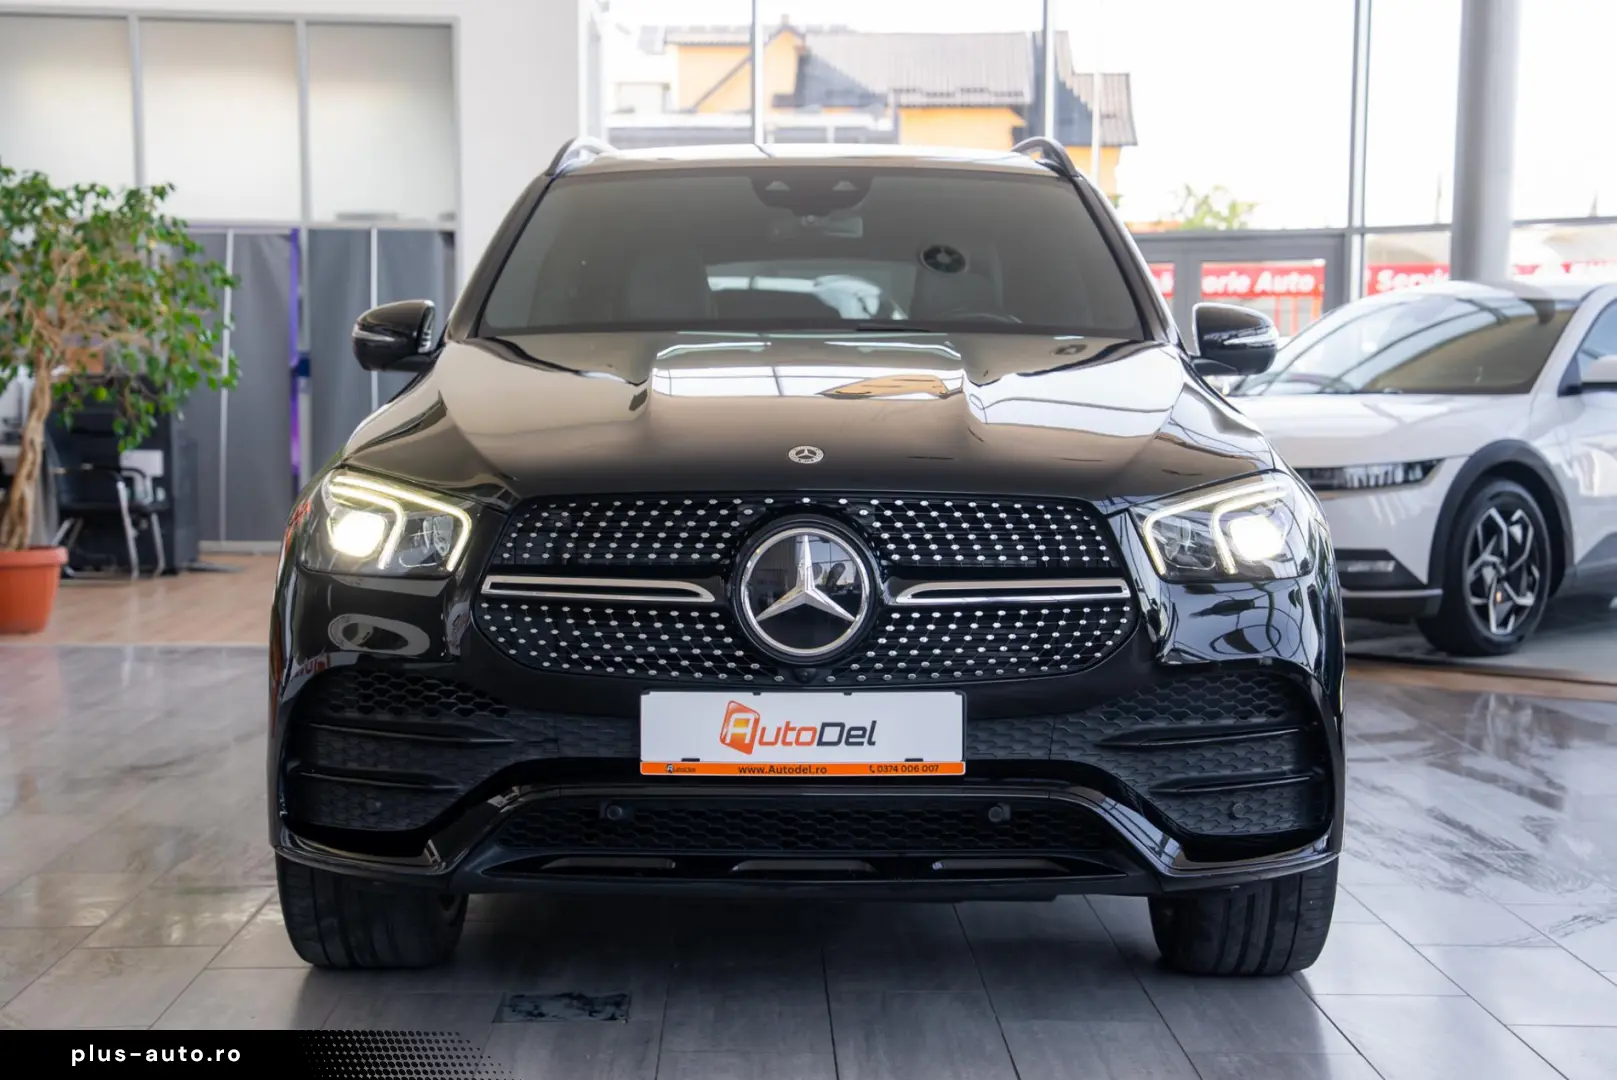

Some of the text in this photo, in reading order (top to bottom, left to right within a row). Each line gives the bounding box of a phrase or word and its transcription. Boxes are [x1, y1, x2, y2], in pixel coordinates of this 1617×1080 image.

[1254, 271, 1316, 292] Auto
[721, 703, 877, 751] AutoDel
[738, 764, 828, 775] www.Autodel.ro
[877, 764, 899, 773] 0374
[901, 764, 919, 773] 006
[922, 764, 939, 773] 007
